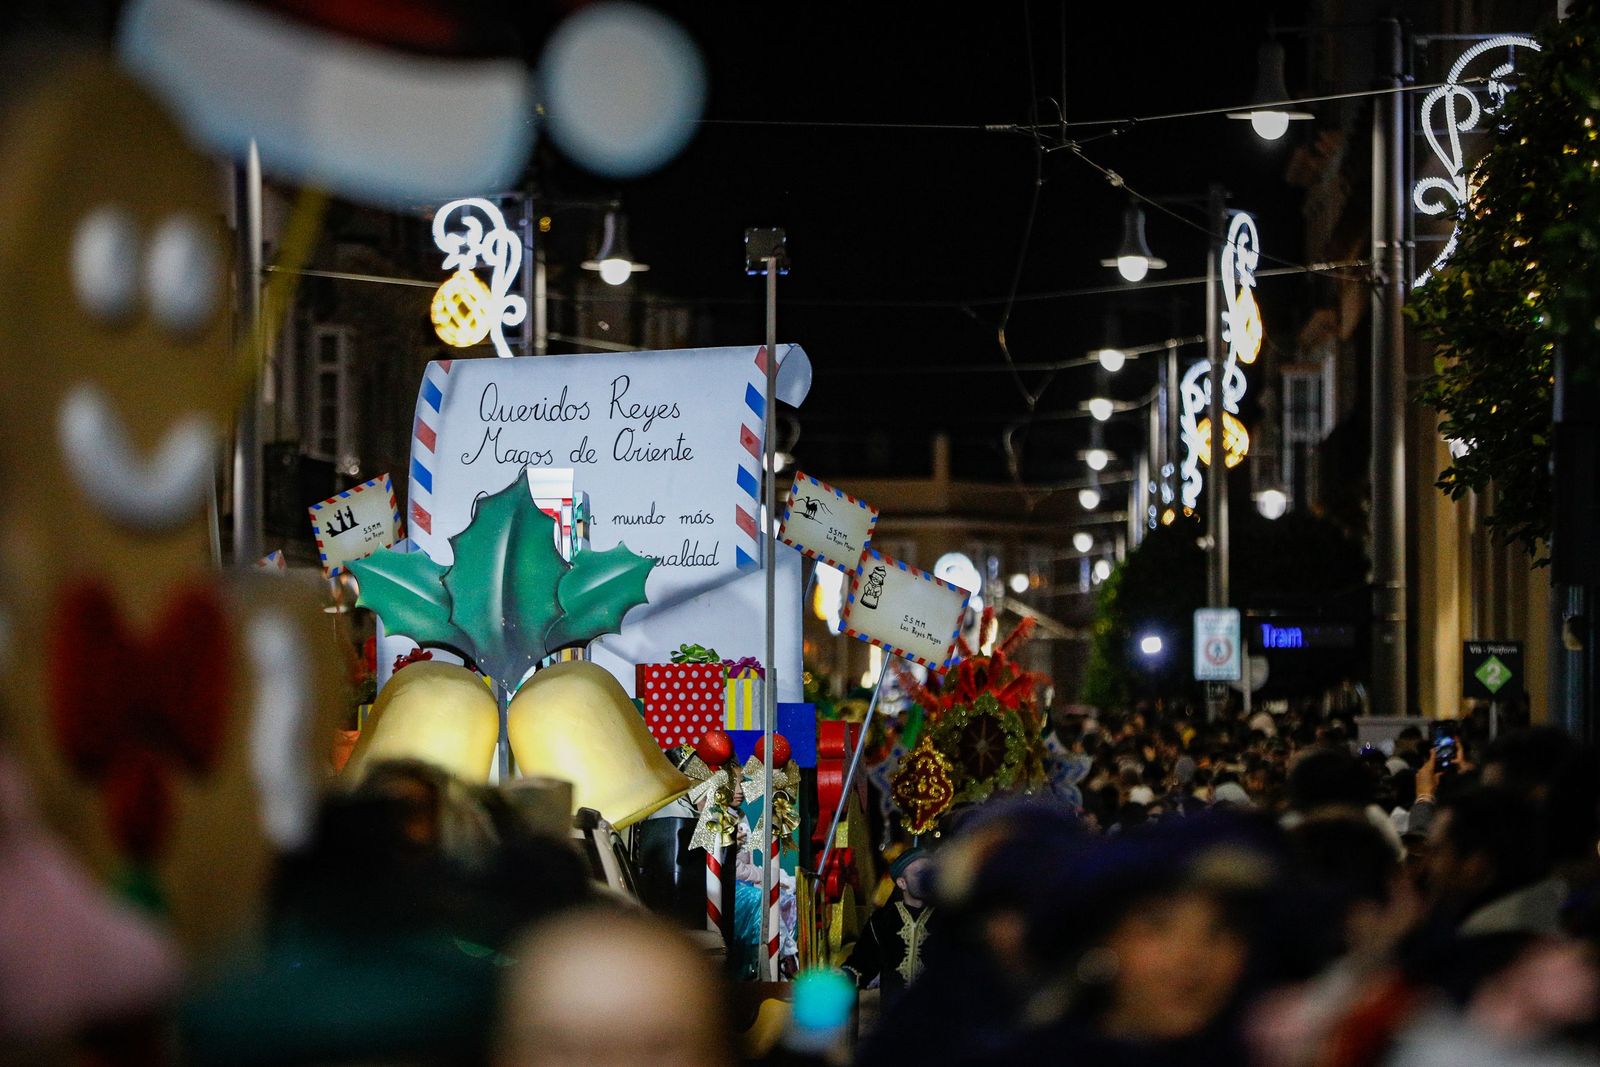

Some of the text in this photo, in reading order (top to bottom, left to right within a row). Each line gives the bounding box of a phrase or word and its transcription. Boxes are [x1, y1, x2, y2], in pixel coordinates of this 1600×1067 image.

[479, 374, 681, 432] Queridos Reyes
[460, 426, 694, 470] Magos de Oriente
[611, 500, 666, 525] mundo
[678, 509, 715, 525] más
[912, 626, 925, 638] Reyes
[926, 632, 942, 646] Magos
[1261, 623, 1303, 648] Tram
[1487, 663, 1501, 685] 2
